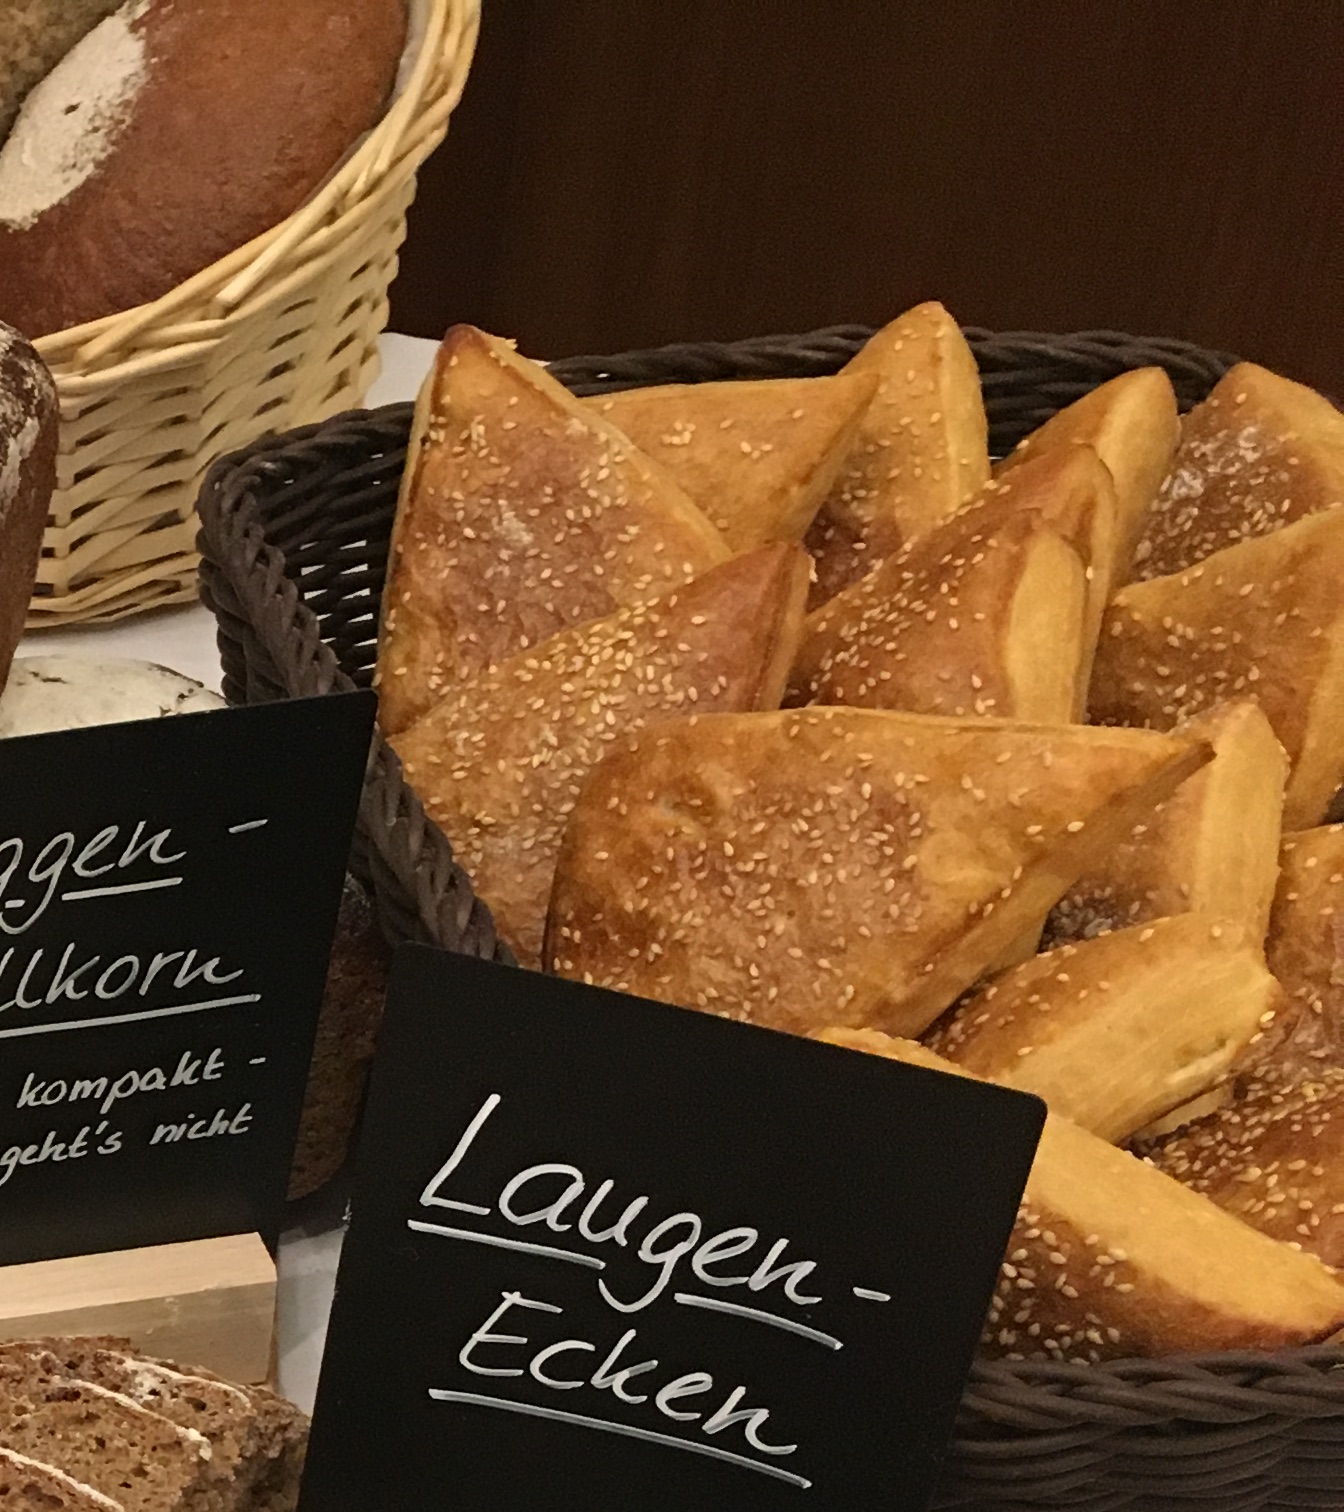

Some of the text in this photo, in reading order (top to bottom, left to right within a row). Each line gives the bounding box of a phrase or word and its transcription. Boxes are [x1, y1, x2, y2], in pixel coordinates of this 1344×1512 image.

[16, 1047, 226, 1107] kompakt
[150, 1102, 254, 1146] nicht
[419, 1092, 892, 1314] Laugen-
[457, 1289, 799, 1456] Ecken
